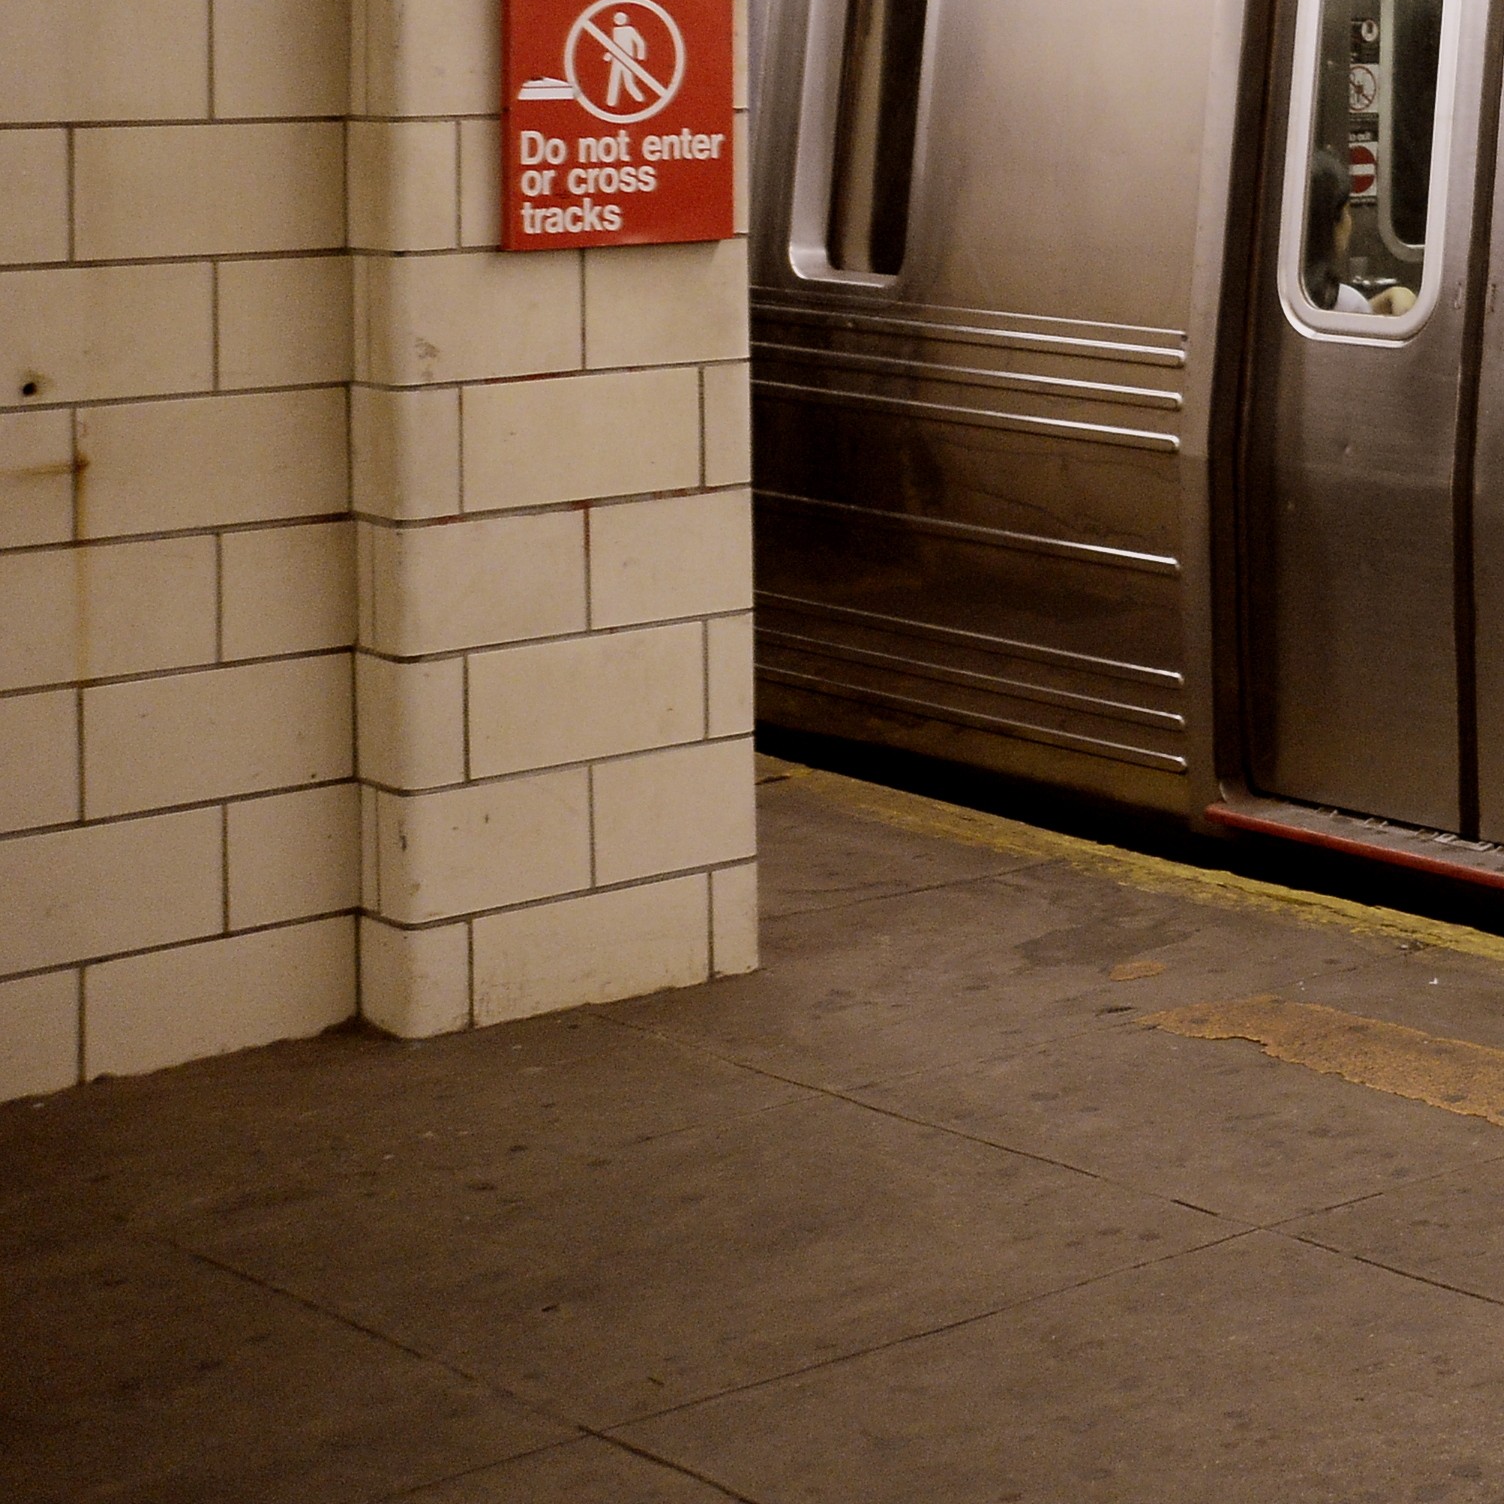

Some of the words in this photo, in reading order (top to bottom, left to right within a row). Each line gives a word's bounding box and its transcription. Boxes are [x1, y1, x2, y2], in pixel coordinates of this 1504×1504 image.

[521, 129, 566, 166] Do
[578, 129, 632, 163] not
[642, 128, 726, 163] enter
[521, 167, 560, 197] or
[567, 164, 658, 194] cross
[521, 200, 624, 236] tracks
